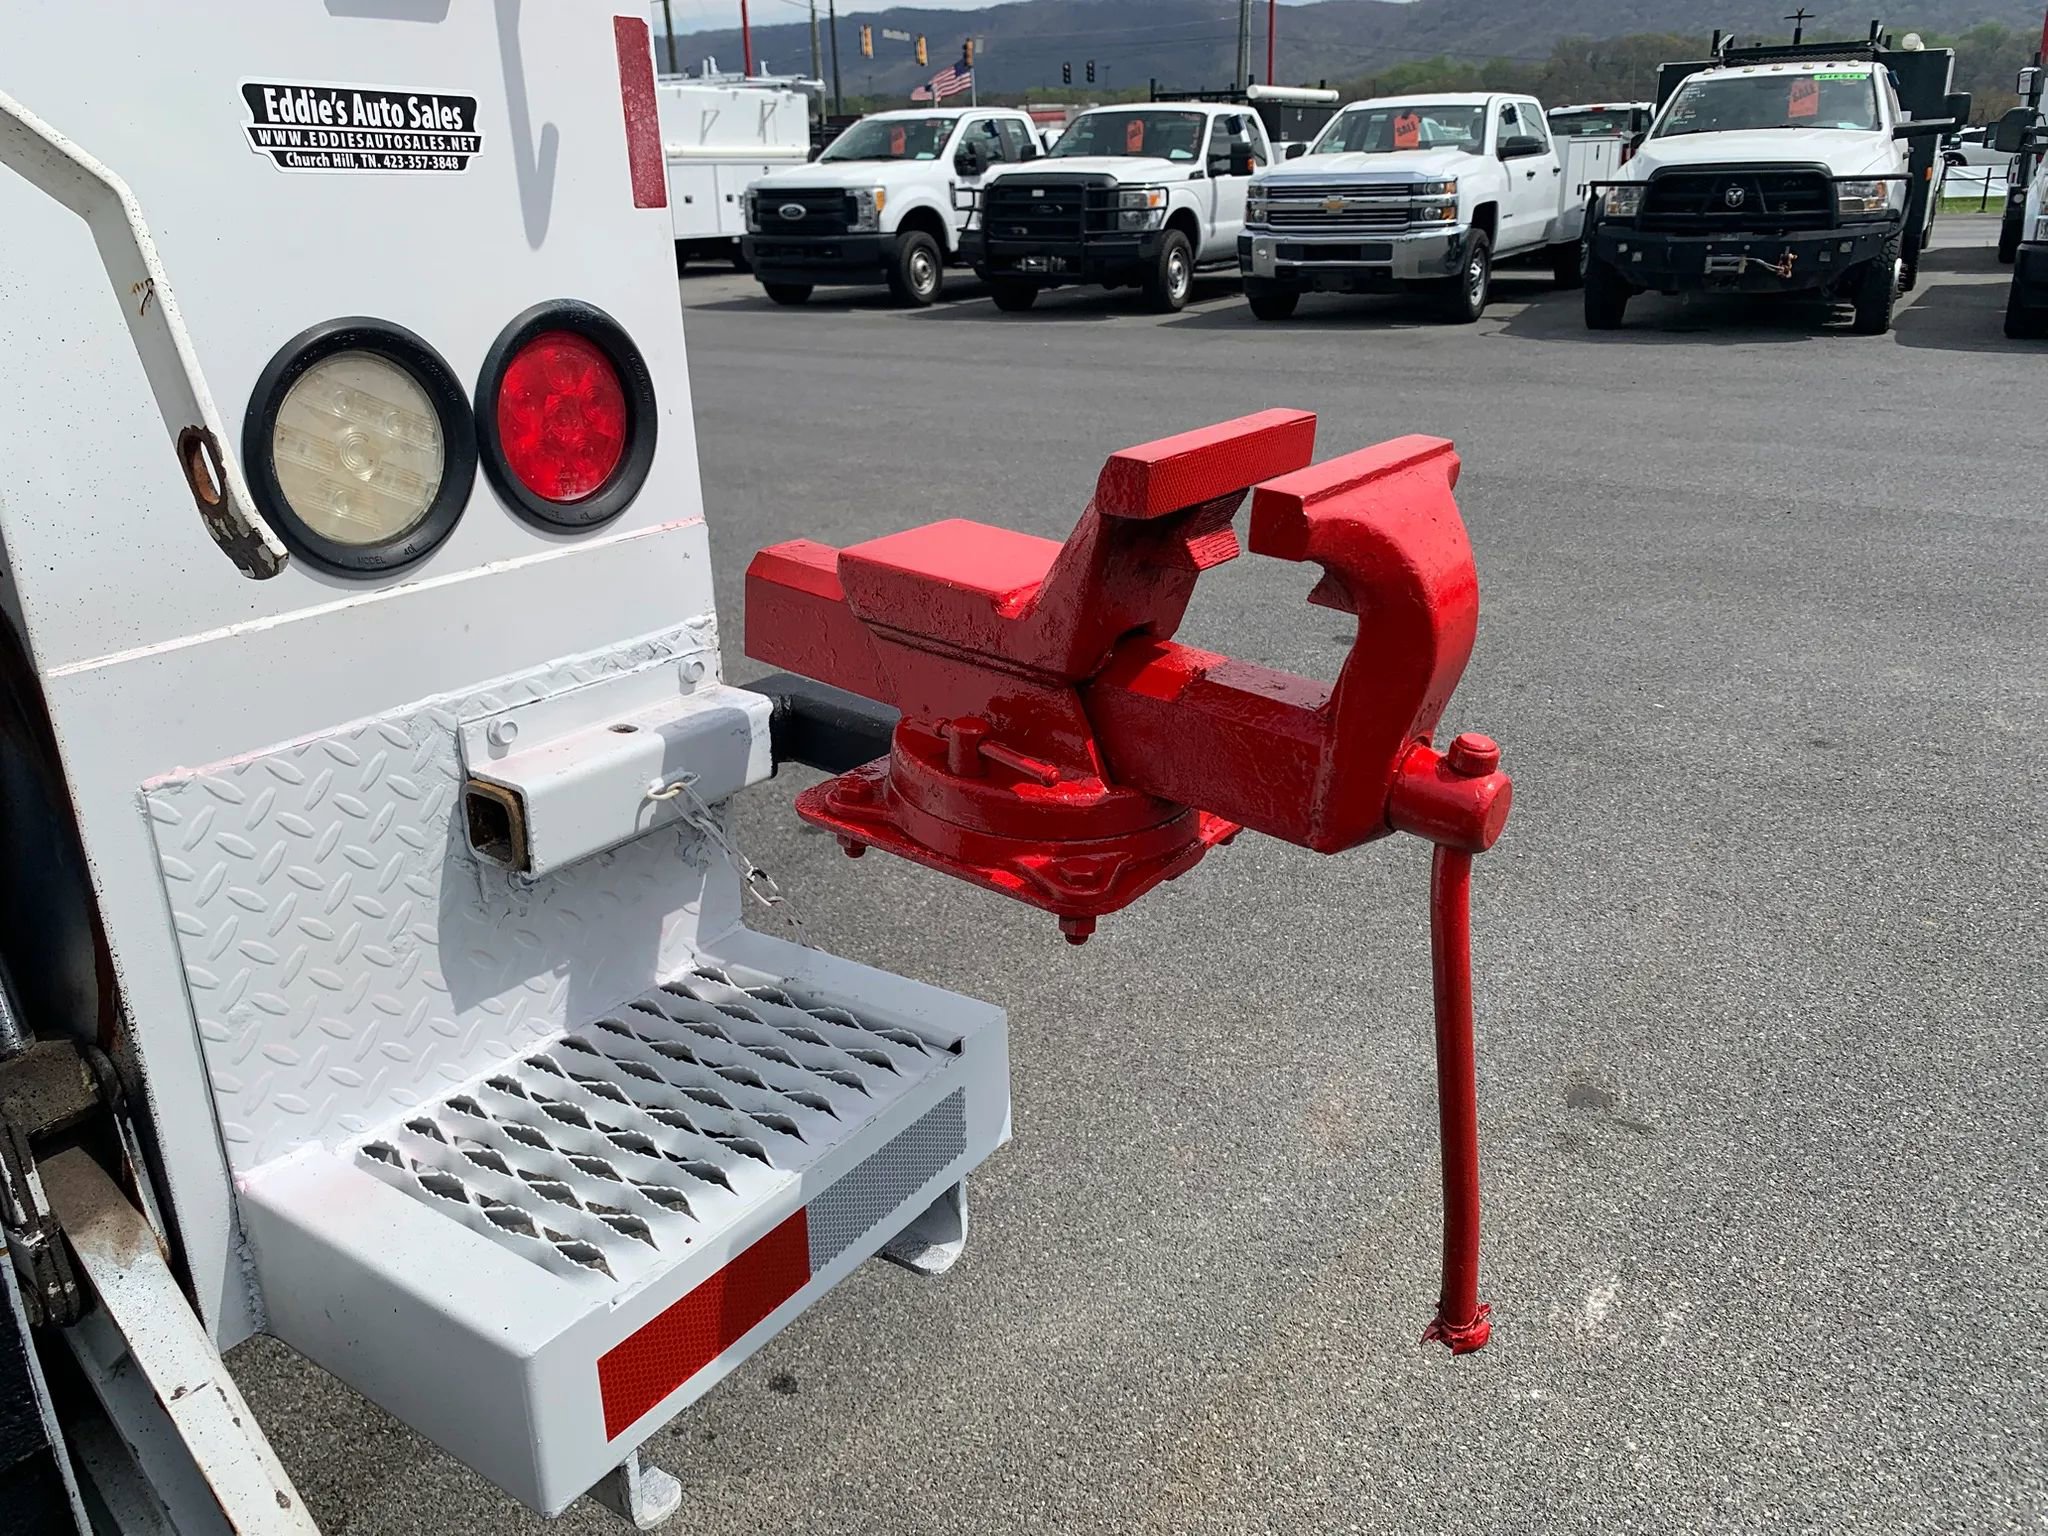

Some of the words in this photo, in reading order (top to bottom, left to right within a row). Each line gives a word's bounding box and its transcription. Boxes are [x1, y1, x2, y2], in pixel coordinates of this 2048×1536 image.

[1792, 82, 1817, 102] SALE
[263, 87, 348, 125] Eddie's
[353, 93, 404, 128] Auto
[407, 96, 463, 130] Sales
[257, 129, 475, 151] WWW.EDDIESAUTOSALES.NET
[286, 152, 331, 167] Church
[332, 153, 359, 170] Hill,
[360, 154, 381, 168] TN.
[383, 155, 459, 169] 423-357-3848
